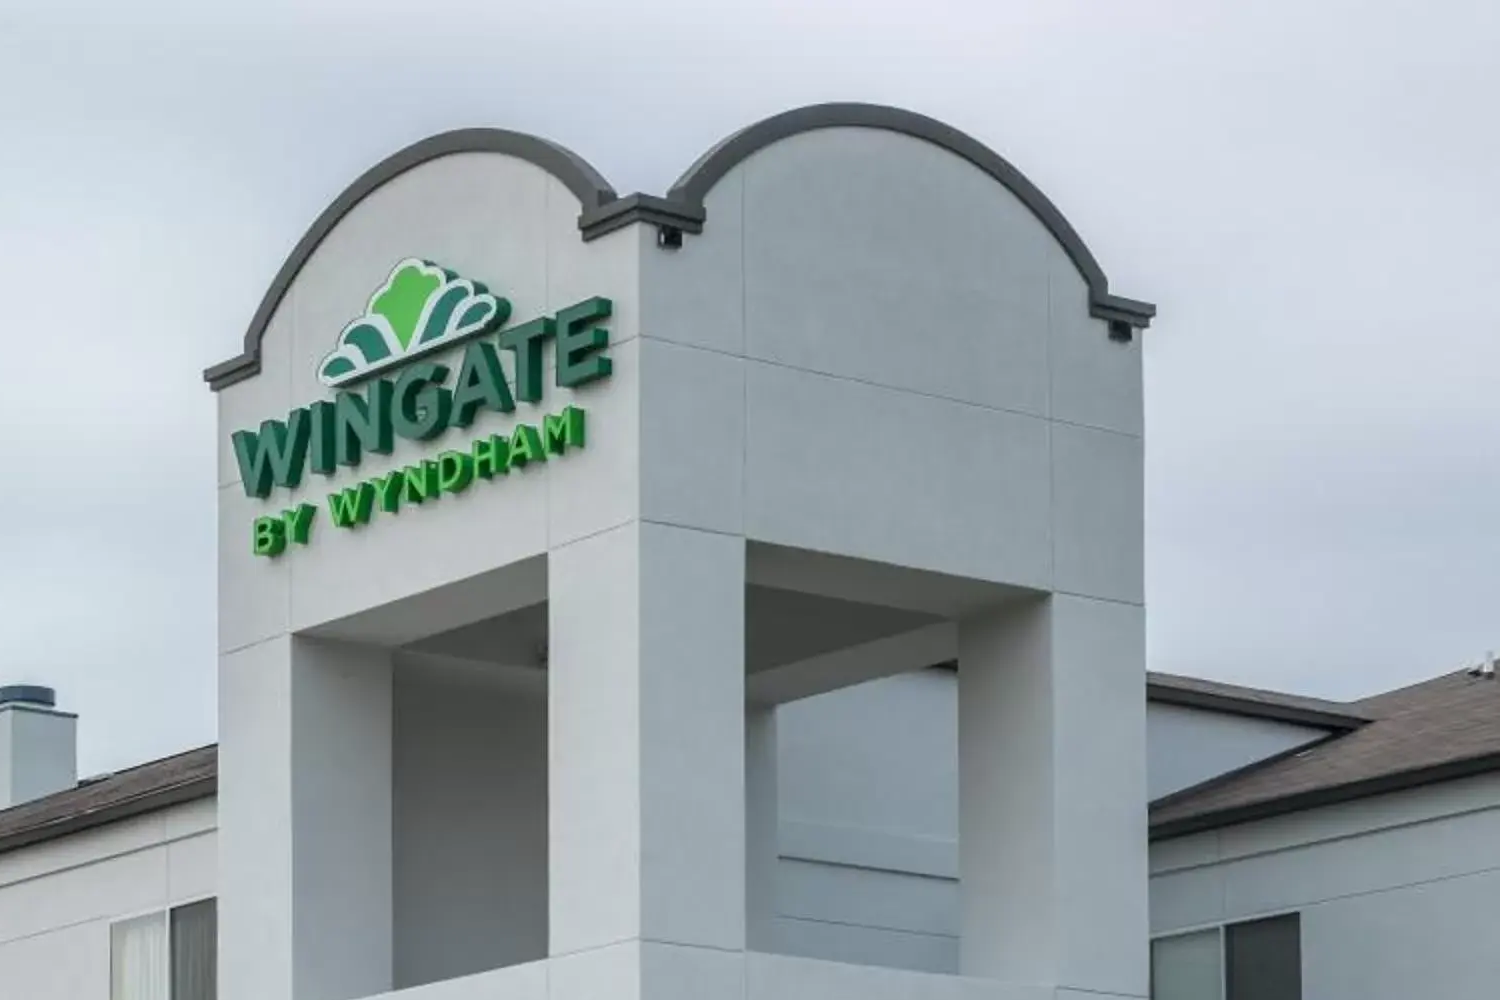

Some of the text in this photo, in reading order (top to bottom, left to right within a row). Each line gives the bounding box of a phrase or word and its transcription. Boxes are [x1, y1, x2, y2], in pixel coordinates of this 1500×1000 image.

[232, 296, 612, 498] WINGATE
[253, 404, 585, 557] BY WYNDHAM
